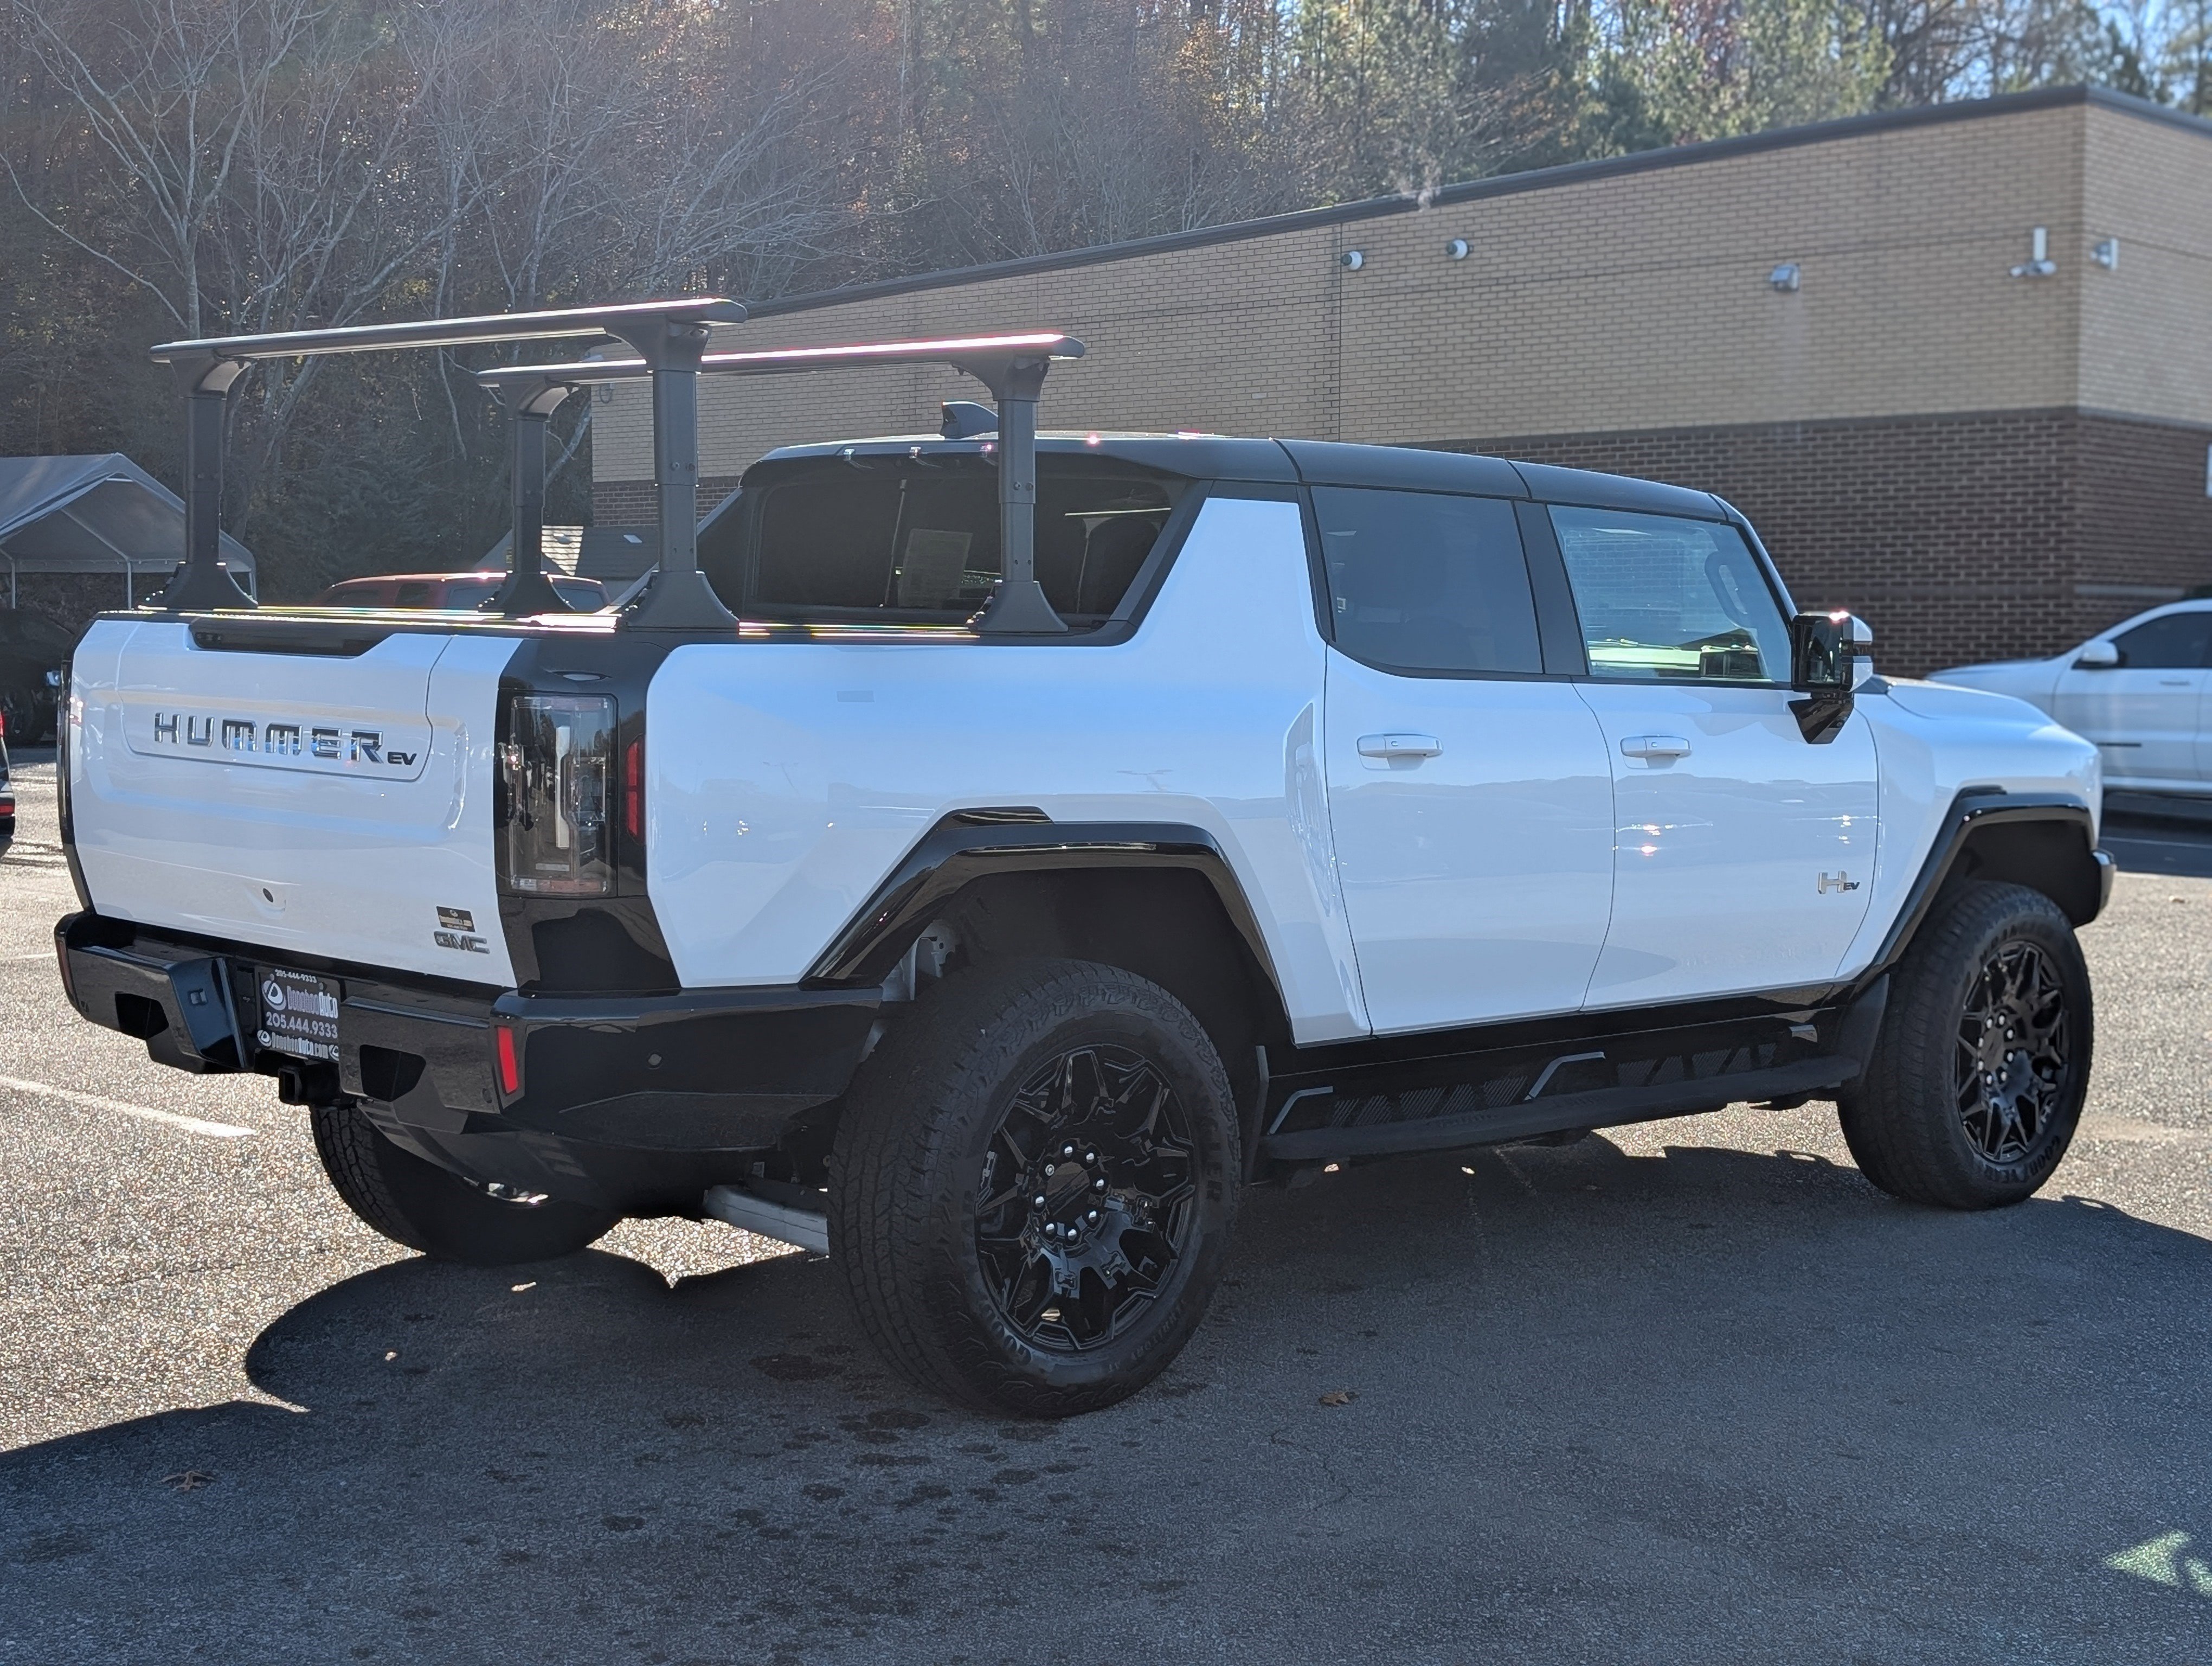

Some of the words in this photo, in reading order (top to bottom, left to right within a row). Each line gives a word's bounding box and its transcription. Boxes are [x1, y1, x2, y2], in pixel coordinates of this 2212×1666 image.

[155, 712, 383, 764] HUMMER
[387, 751, 417, 765] EV
[434, 931, 490, 954] GMC
[266, 1011, 338, 1039] 205.444.9333
